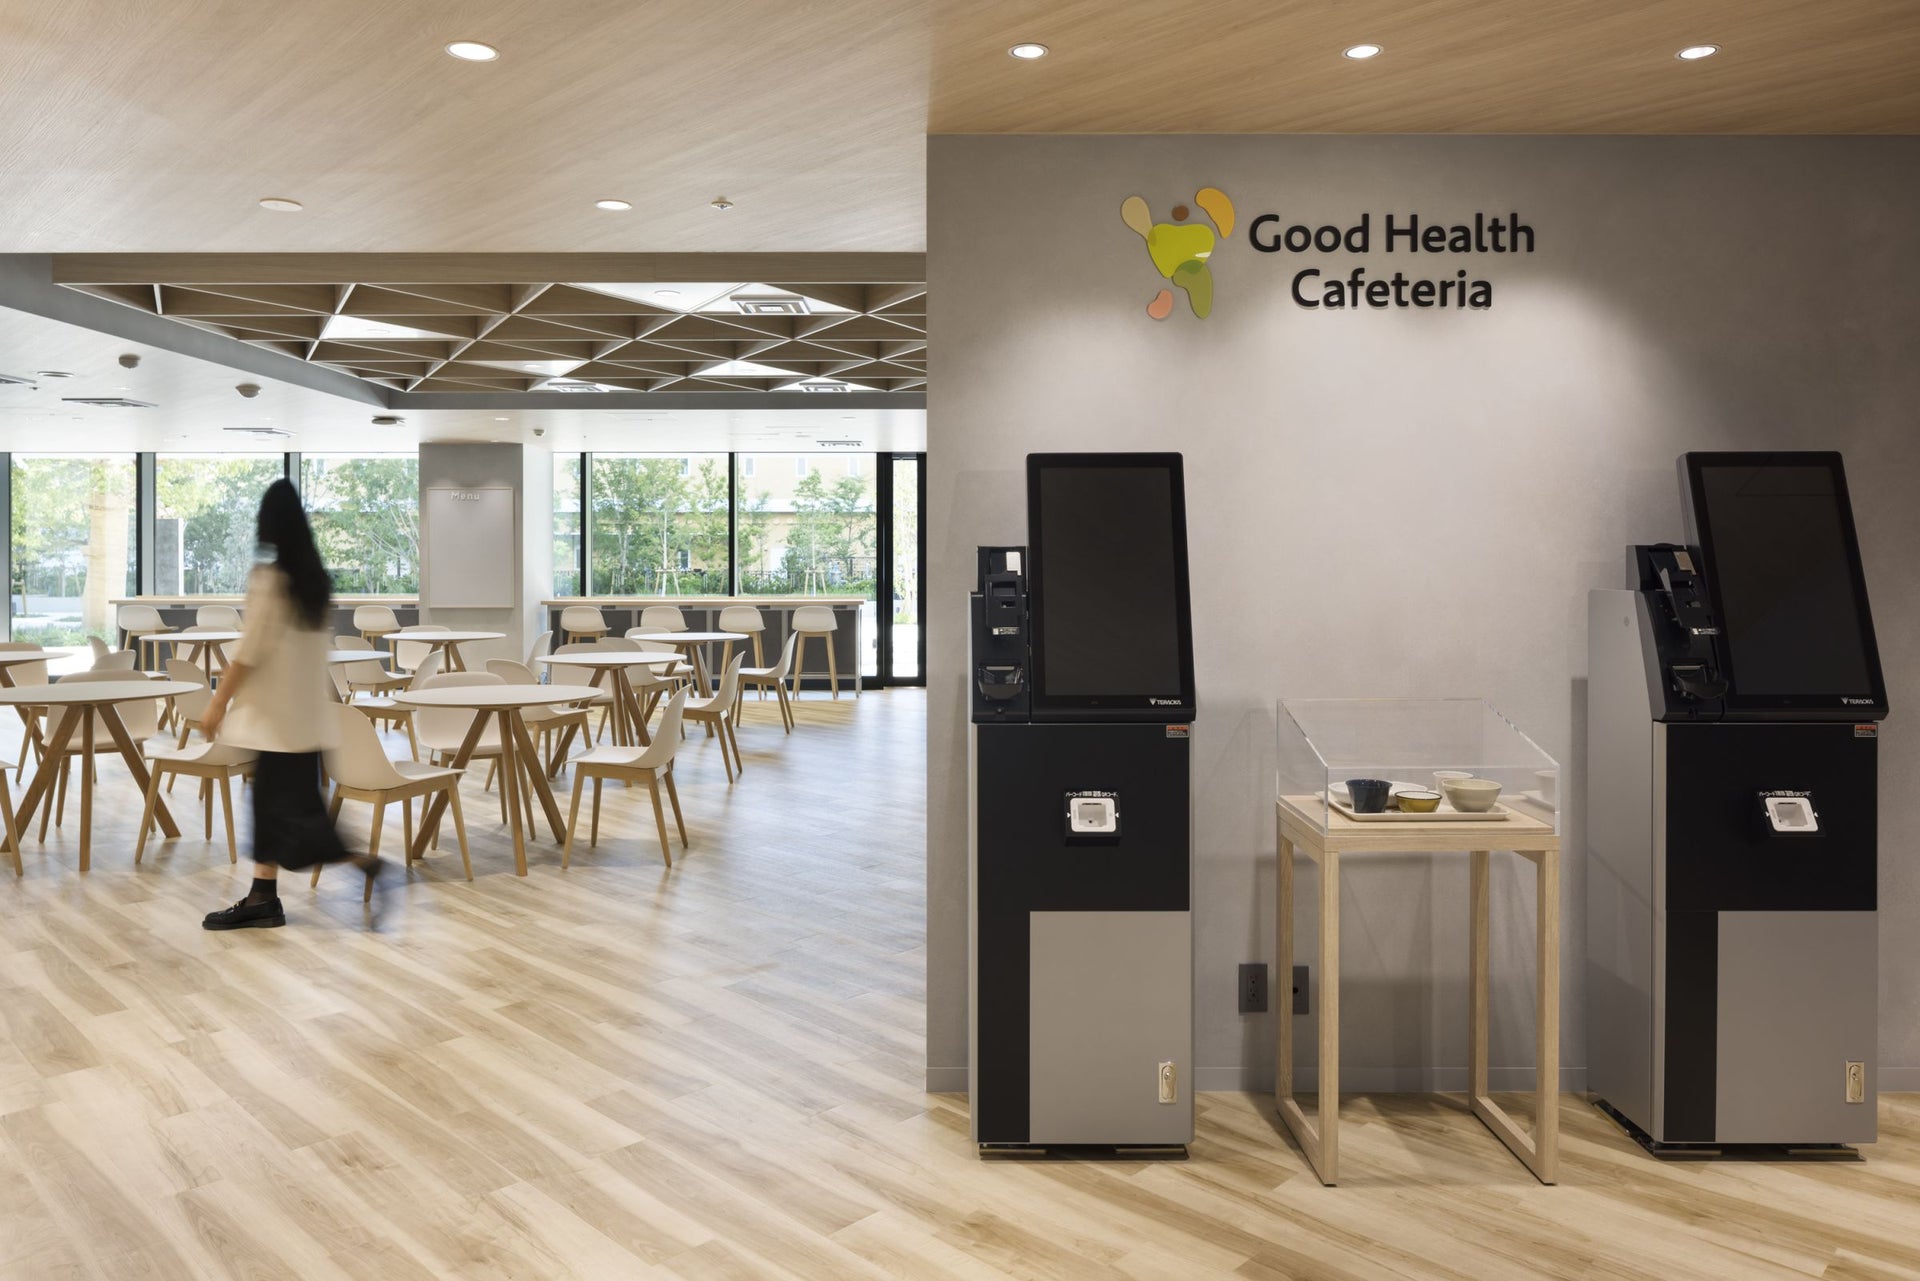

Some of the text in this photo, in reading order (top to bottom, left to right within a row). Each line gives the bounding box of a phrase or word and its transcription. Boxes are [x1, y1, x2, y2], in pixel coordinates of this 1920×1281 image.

[1249, 213, 1535, 253] Good Health
[1291, 267, 1492, 308] Cafeteria
[450, 491, 480, 501] Menu
